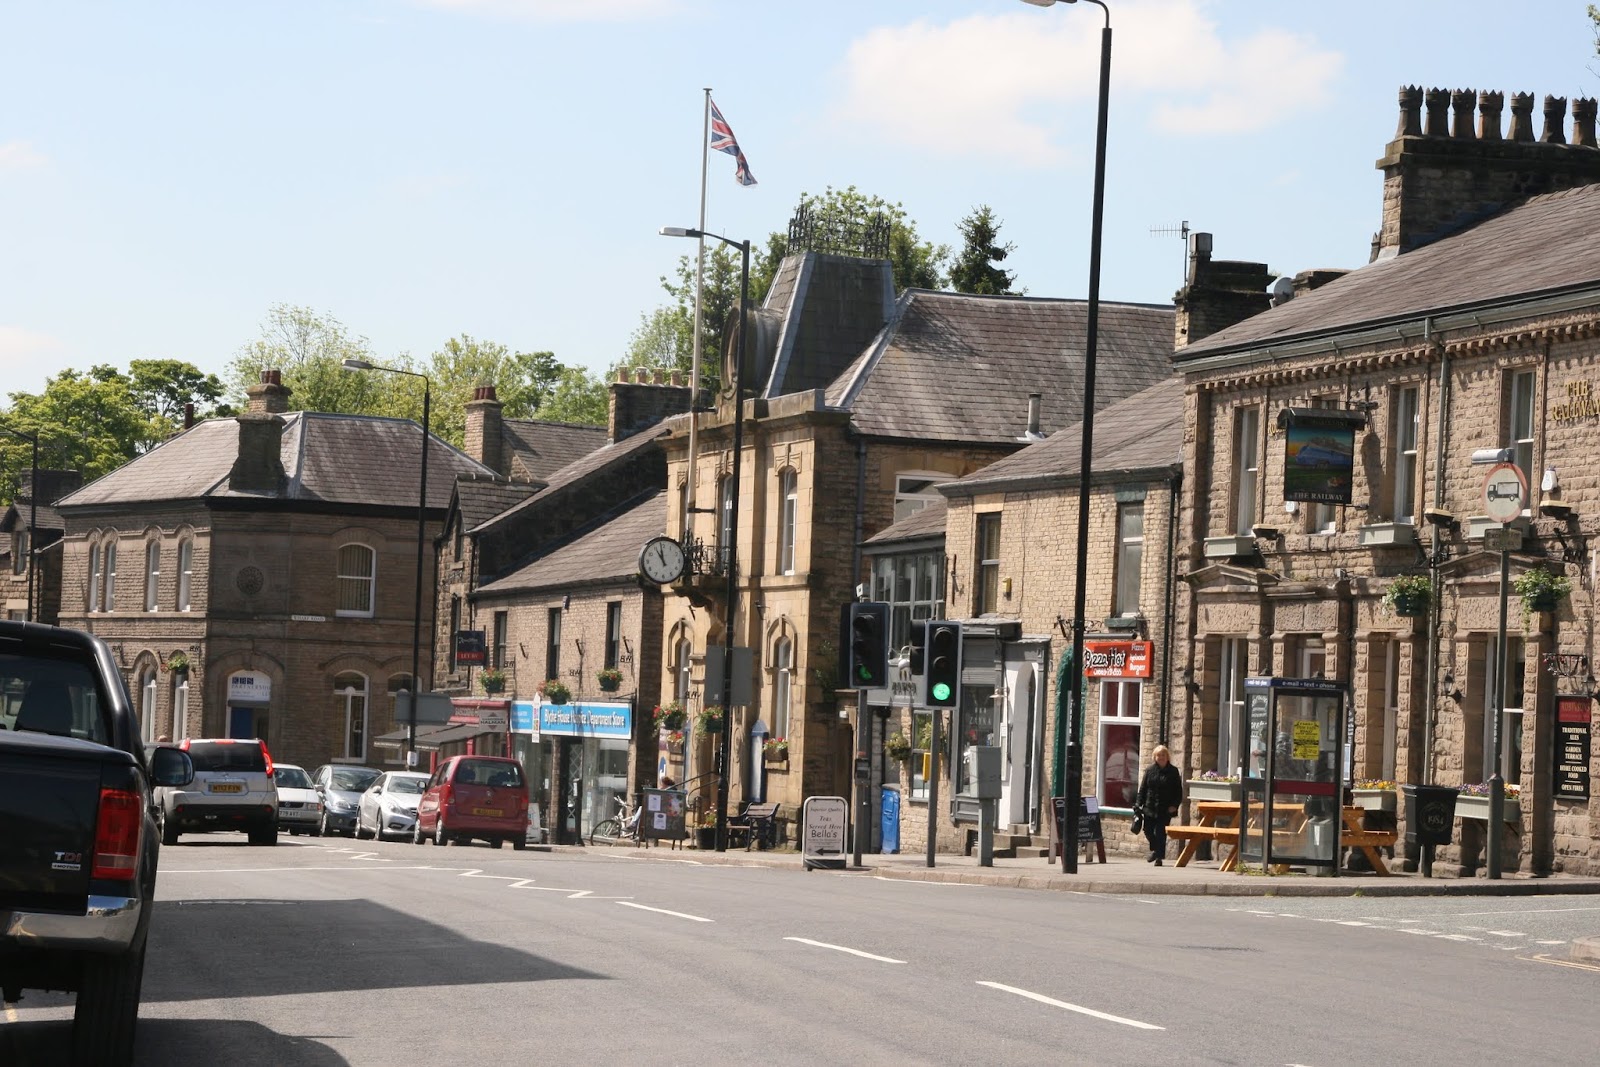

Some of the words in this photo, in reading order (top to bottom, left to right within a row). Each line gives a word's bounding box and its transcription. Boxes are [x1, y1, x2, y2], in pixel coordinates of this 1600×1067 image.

[1563, 380, 1588, 397] THE
[1551, 400, 1600, 420] RAILWAY
[1571, 765, 1587, 773] COOKED
[1572, 784, 1584, 792] FIRES
[811, 830, 838, 838] Bella's
[54, 851, 82, 863] TDI
